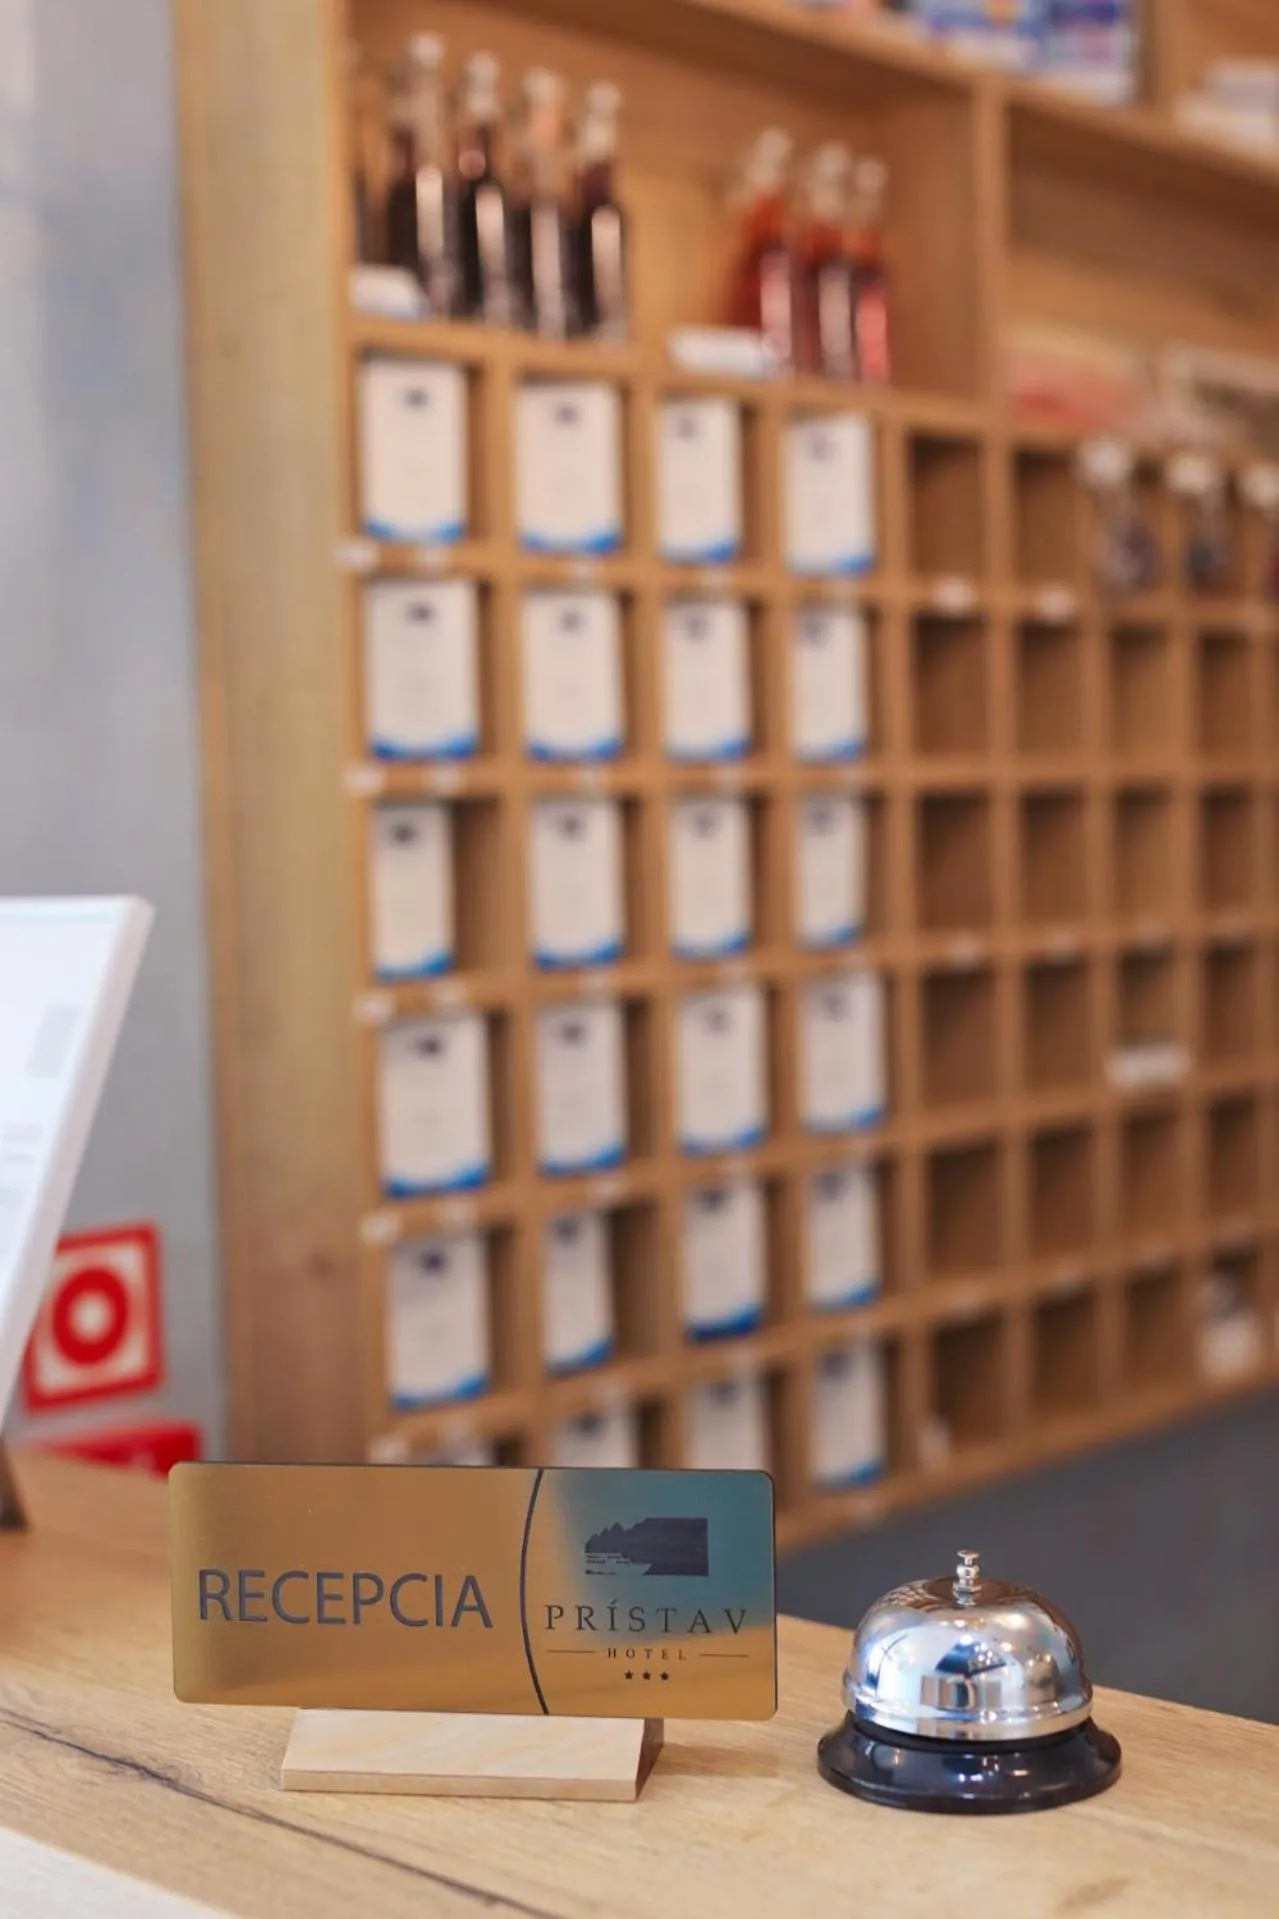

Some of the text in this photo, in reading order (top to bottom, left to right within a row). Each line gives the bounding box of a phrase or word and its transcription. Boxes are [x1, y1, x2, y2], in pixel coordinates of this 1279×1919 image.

[199, 1568, 493, 1628] RECEPCIA
[545, 1599, 746, 1634] PRÍSTAV
[607, 1648, 686, 1661] HOTEL
